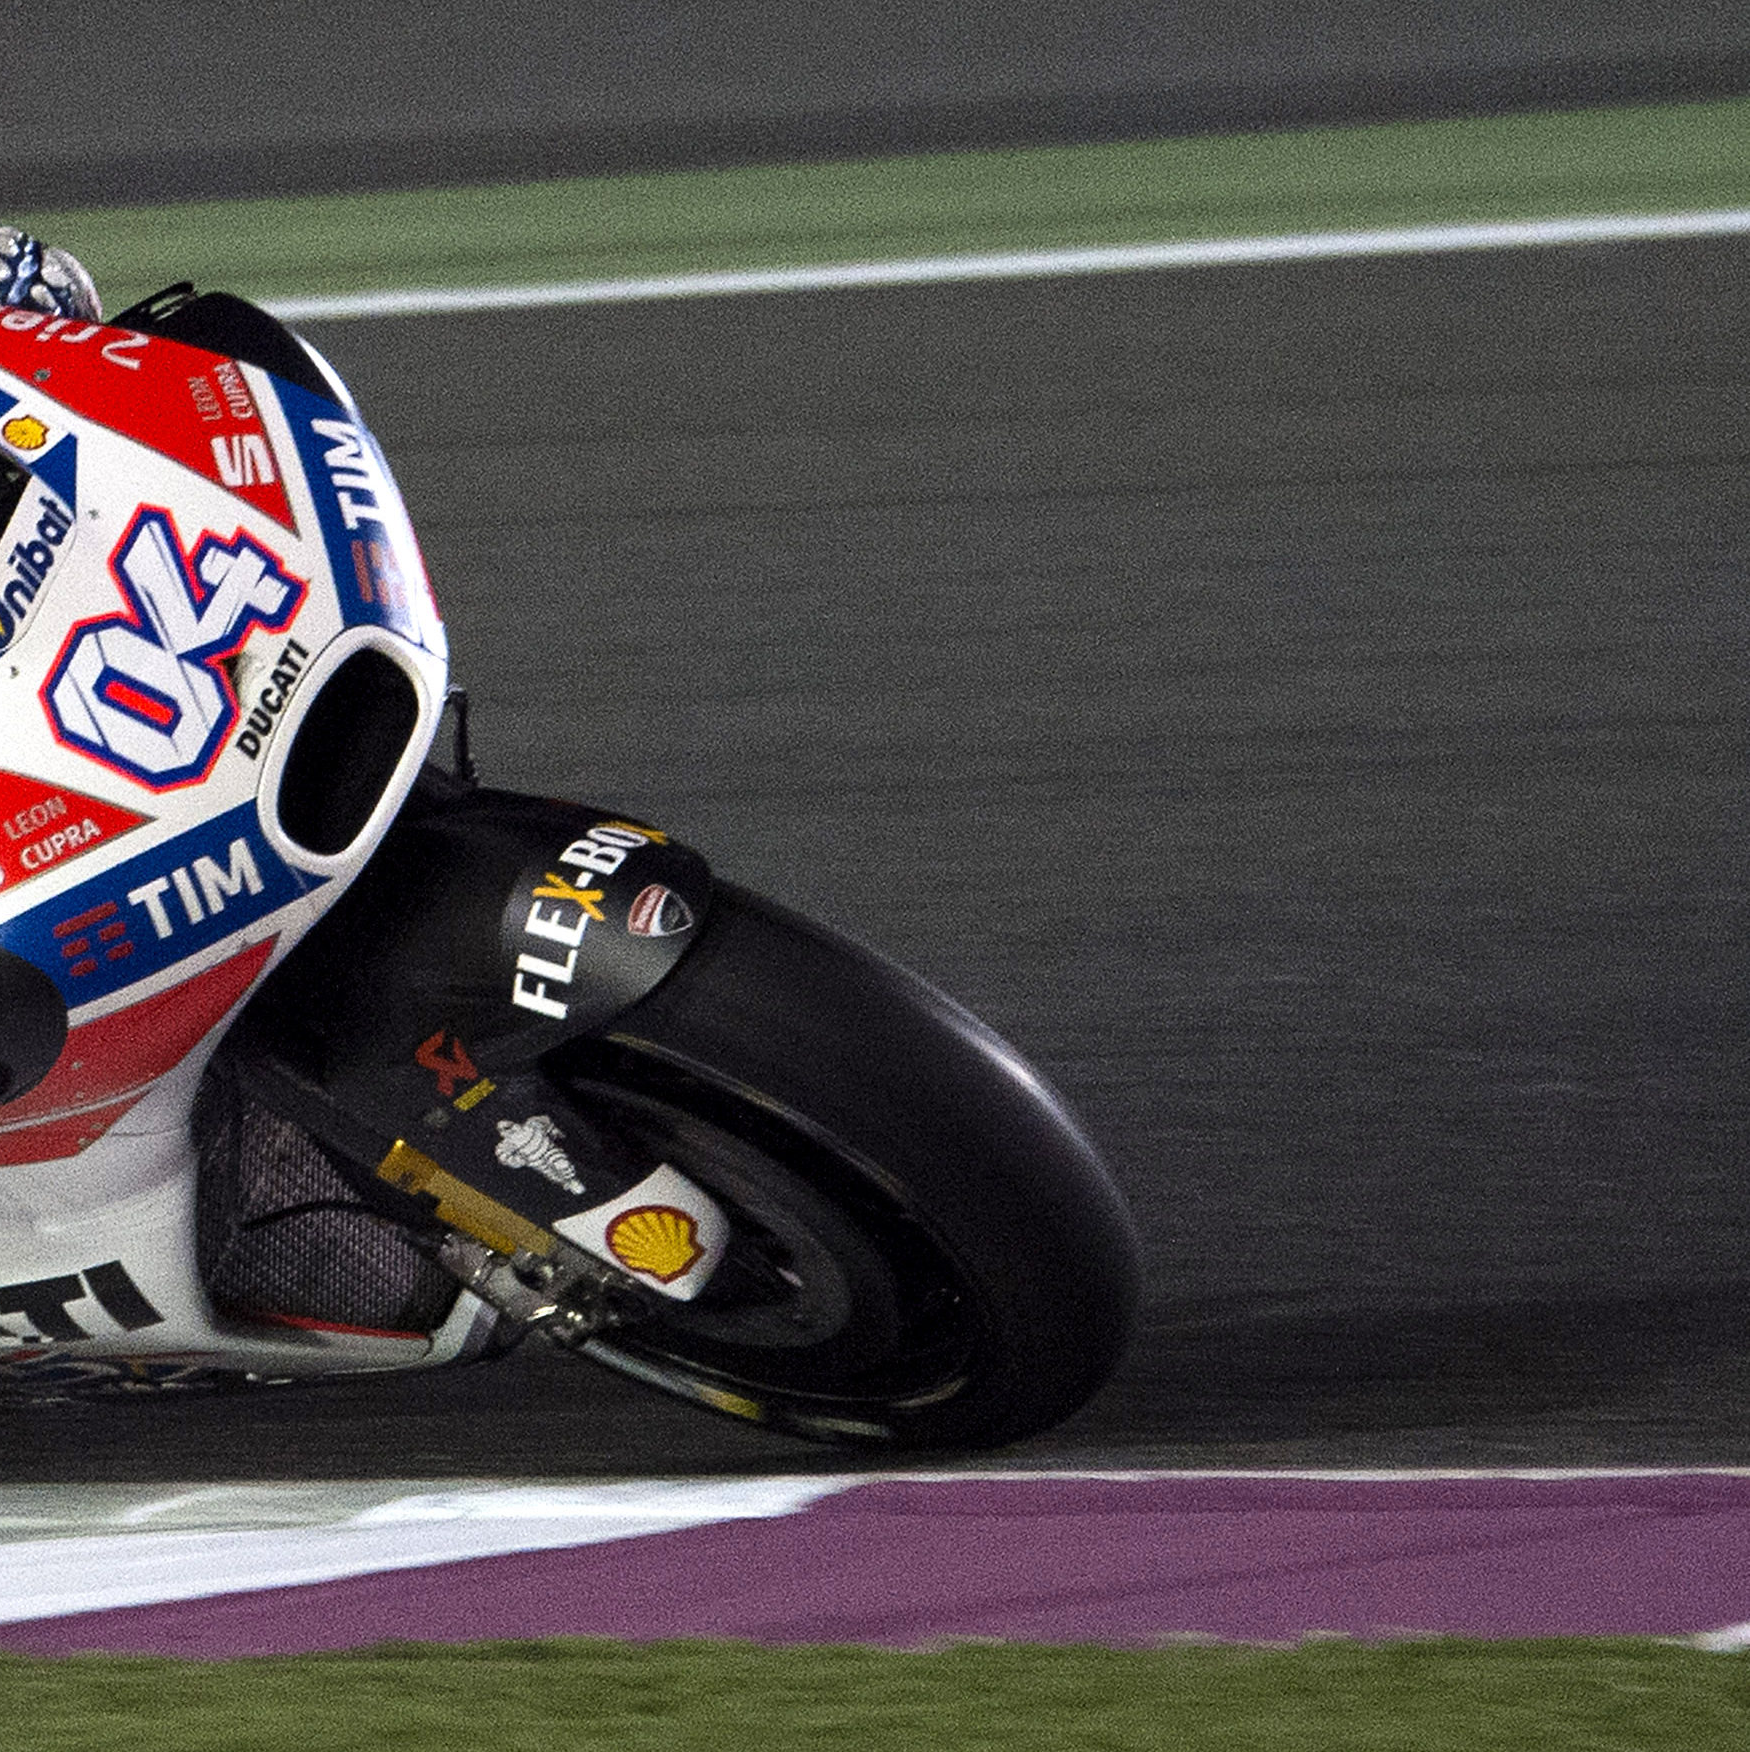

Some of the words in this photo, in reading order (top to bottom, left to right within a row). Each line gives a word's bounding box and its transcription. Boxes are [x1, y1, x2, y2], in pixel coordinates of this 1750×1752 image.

[311, 418, 384, 530] TIM
[38, 502, 310, 793] 04
[235, 641, 310, 761] DUCATI
[3, 796, 68, 842] LEON
[19, 818, 102, 872] CUPRA
[127, 836, 263, 942] TIM
